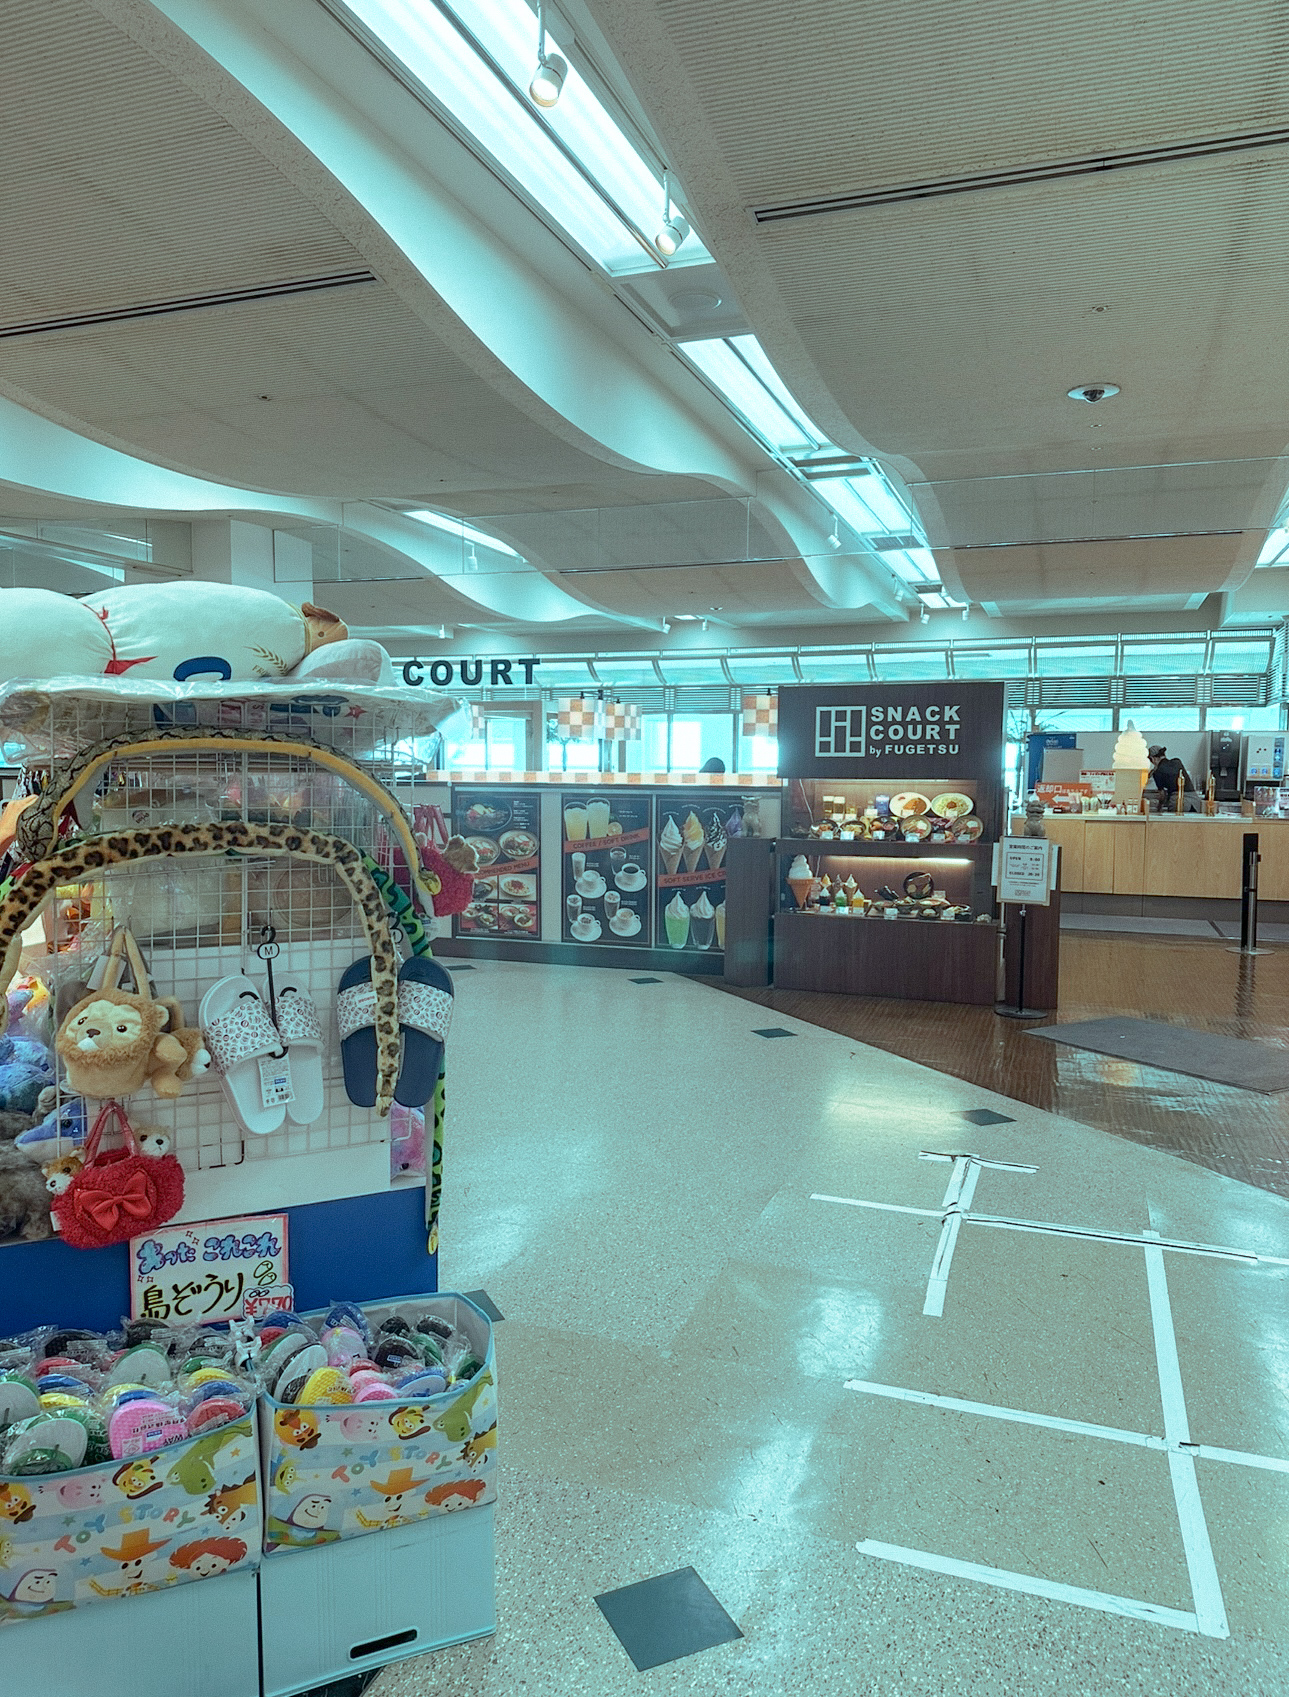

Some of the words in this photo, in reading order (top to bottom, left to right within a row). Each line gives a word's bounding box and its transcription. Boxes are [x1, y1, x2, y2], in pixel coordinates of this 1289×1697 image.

[402, 659, 541, 686] COURT
[870, 705, 961, 722] SNACK
[869, 724, 961, 741] COURT
[869, 745, 881, 758] by
[884, 744, 959, 755] FUGETSU
[572, 841, 597, 849] COFFEE
[602, 837, 618, 845] SOFT
[620, 833, 640, 842] DRINK
[264, 945, 274, 956] M
[136, 1239, 197, 1275] あった
[202, 1231, 282, 1262] これこれ
[330, 1449, 379, 1483] TOY
[388, 1444, 453, 1471] STORY
[53, 1513, 106, 1554] TOY
[119, 1503, 196, 1529] STORY
